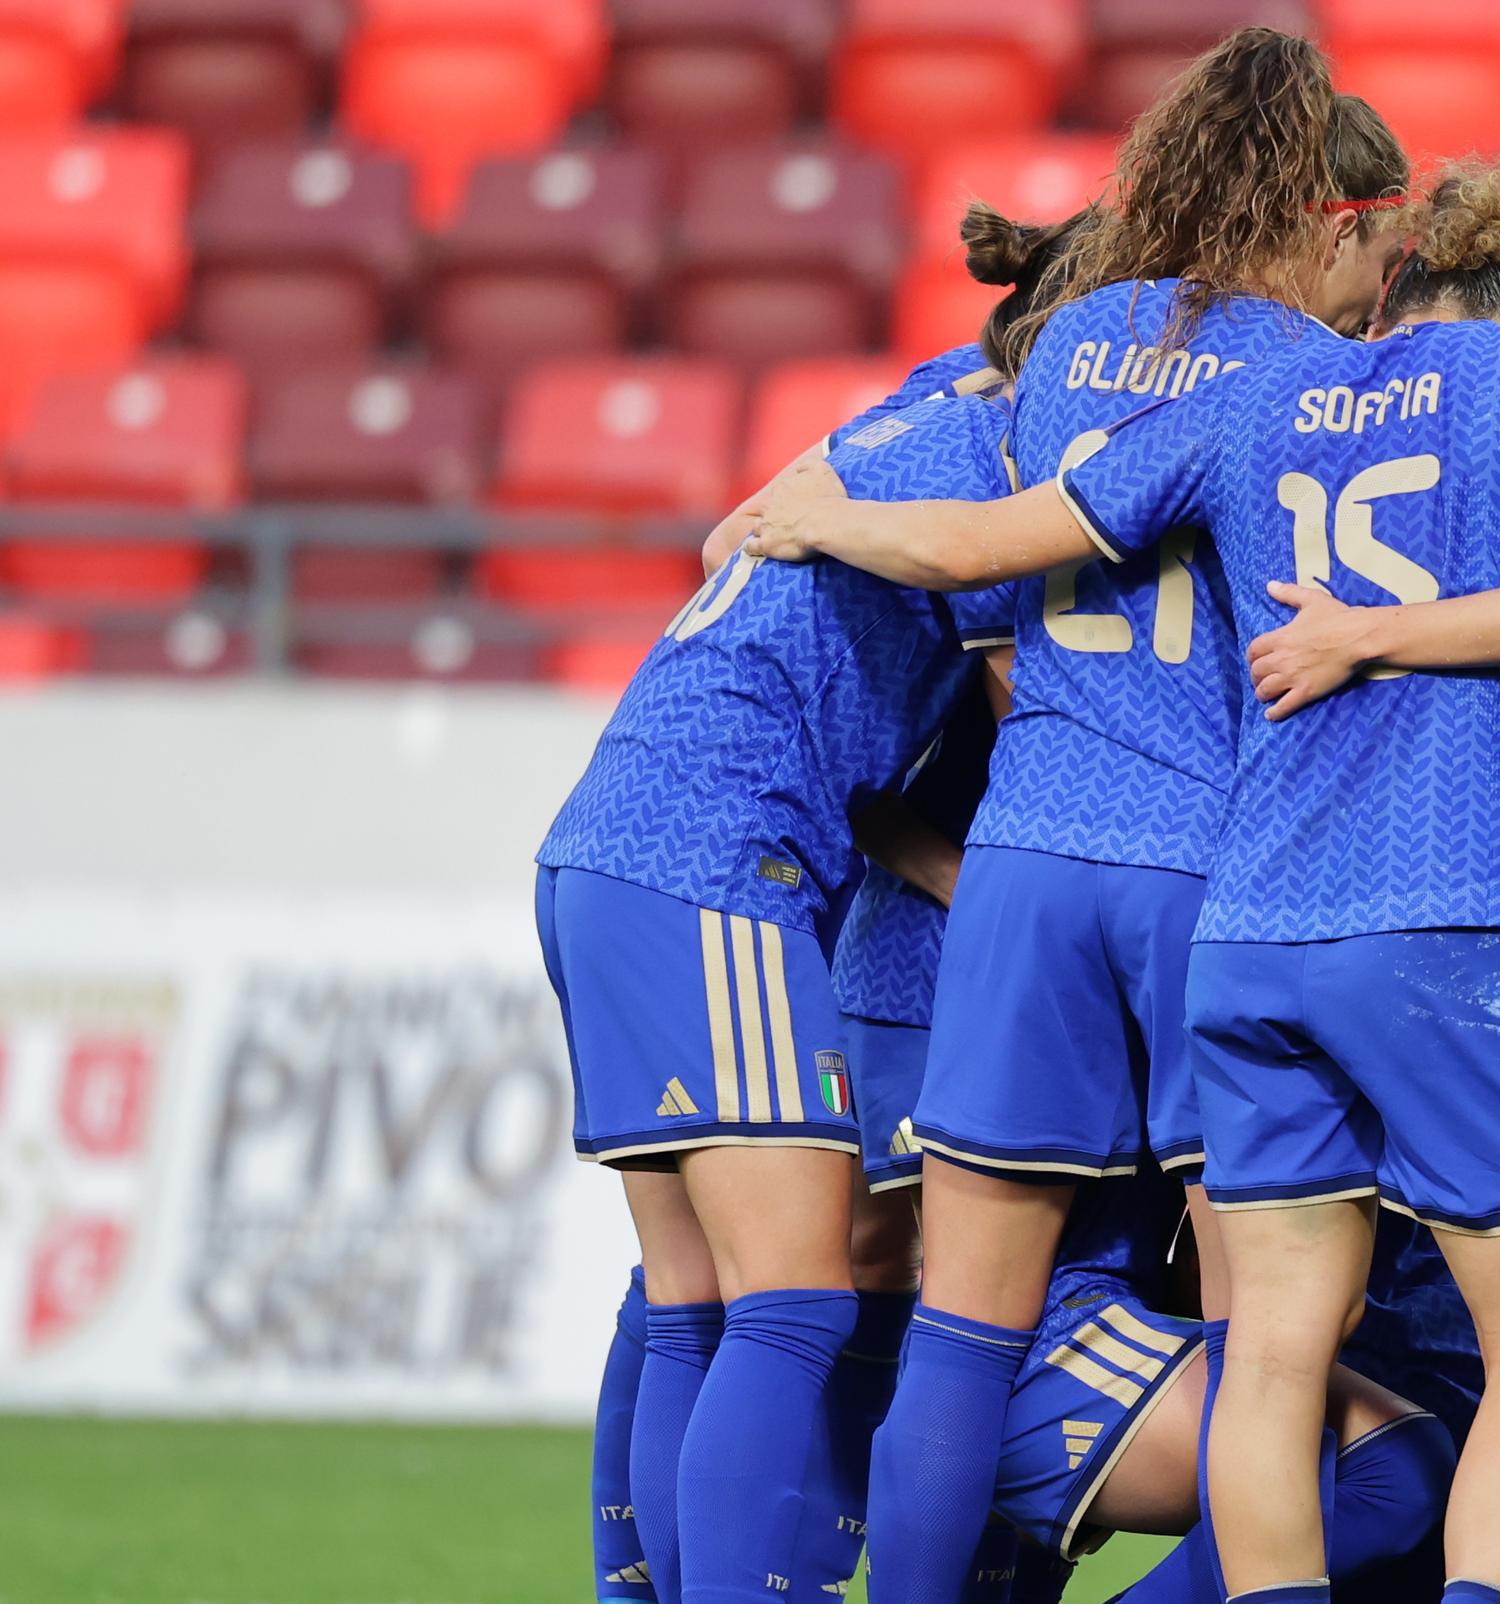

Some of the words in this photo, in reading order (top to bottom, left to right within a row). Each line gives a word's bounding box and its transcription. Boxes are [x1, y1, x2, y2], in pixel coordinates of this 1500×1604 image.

[1294, 372, 1441, 434] SOFFIA
[1277, 454, 1441, 680] 15
[208, 1038, 570, 1200] PIVO
[600, 1505, 634, 1521] ITA
[836, 1515, 868, 1536] ITA
[765, 1572, 790, 1592] ITA
